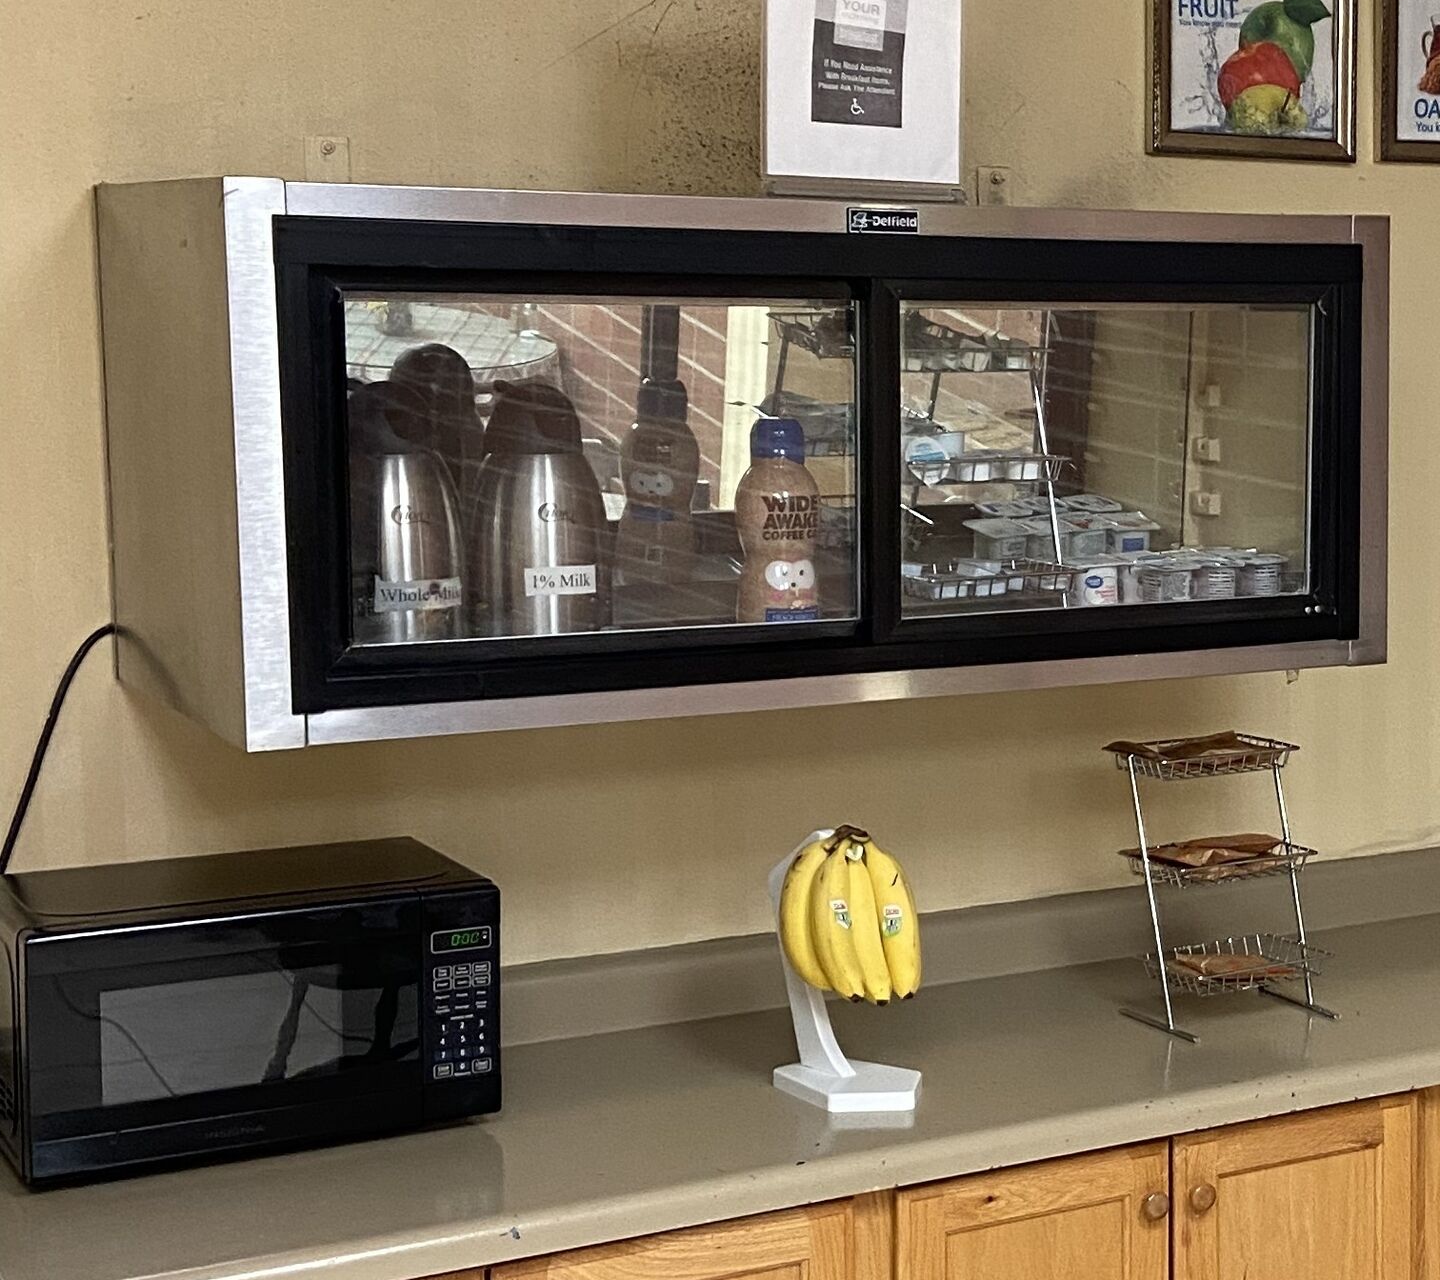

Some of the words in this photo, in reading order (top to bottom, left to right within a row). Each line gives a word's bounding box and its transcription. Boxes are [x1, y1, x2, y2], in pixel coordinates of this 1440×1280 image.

[842, 0, 880, 16] YOUR
[1416, 121, 1433, 133] You
[872, 216, 917, 228] Delfield
[761, 495, 818, 513] WIDE
[762, 530, 803, 541] COFFEE
[533, 574, 555, 589] 1%
[560, 573, 591, 588] Milk
[381, 588, 430, 602] Whole
